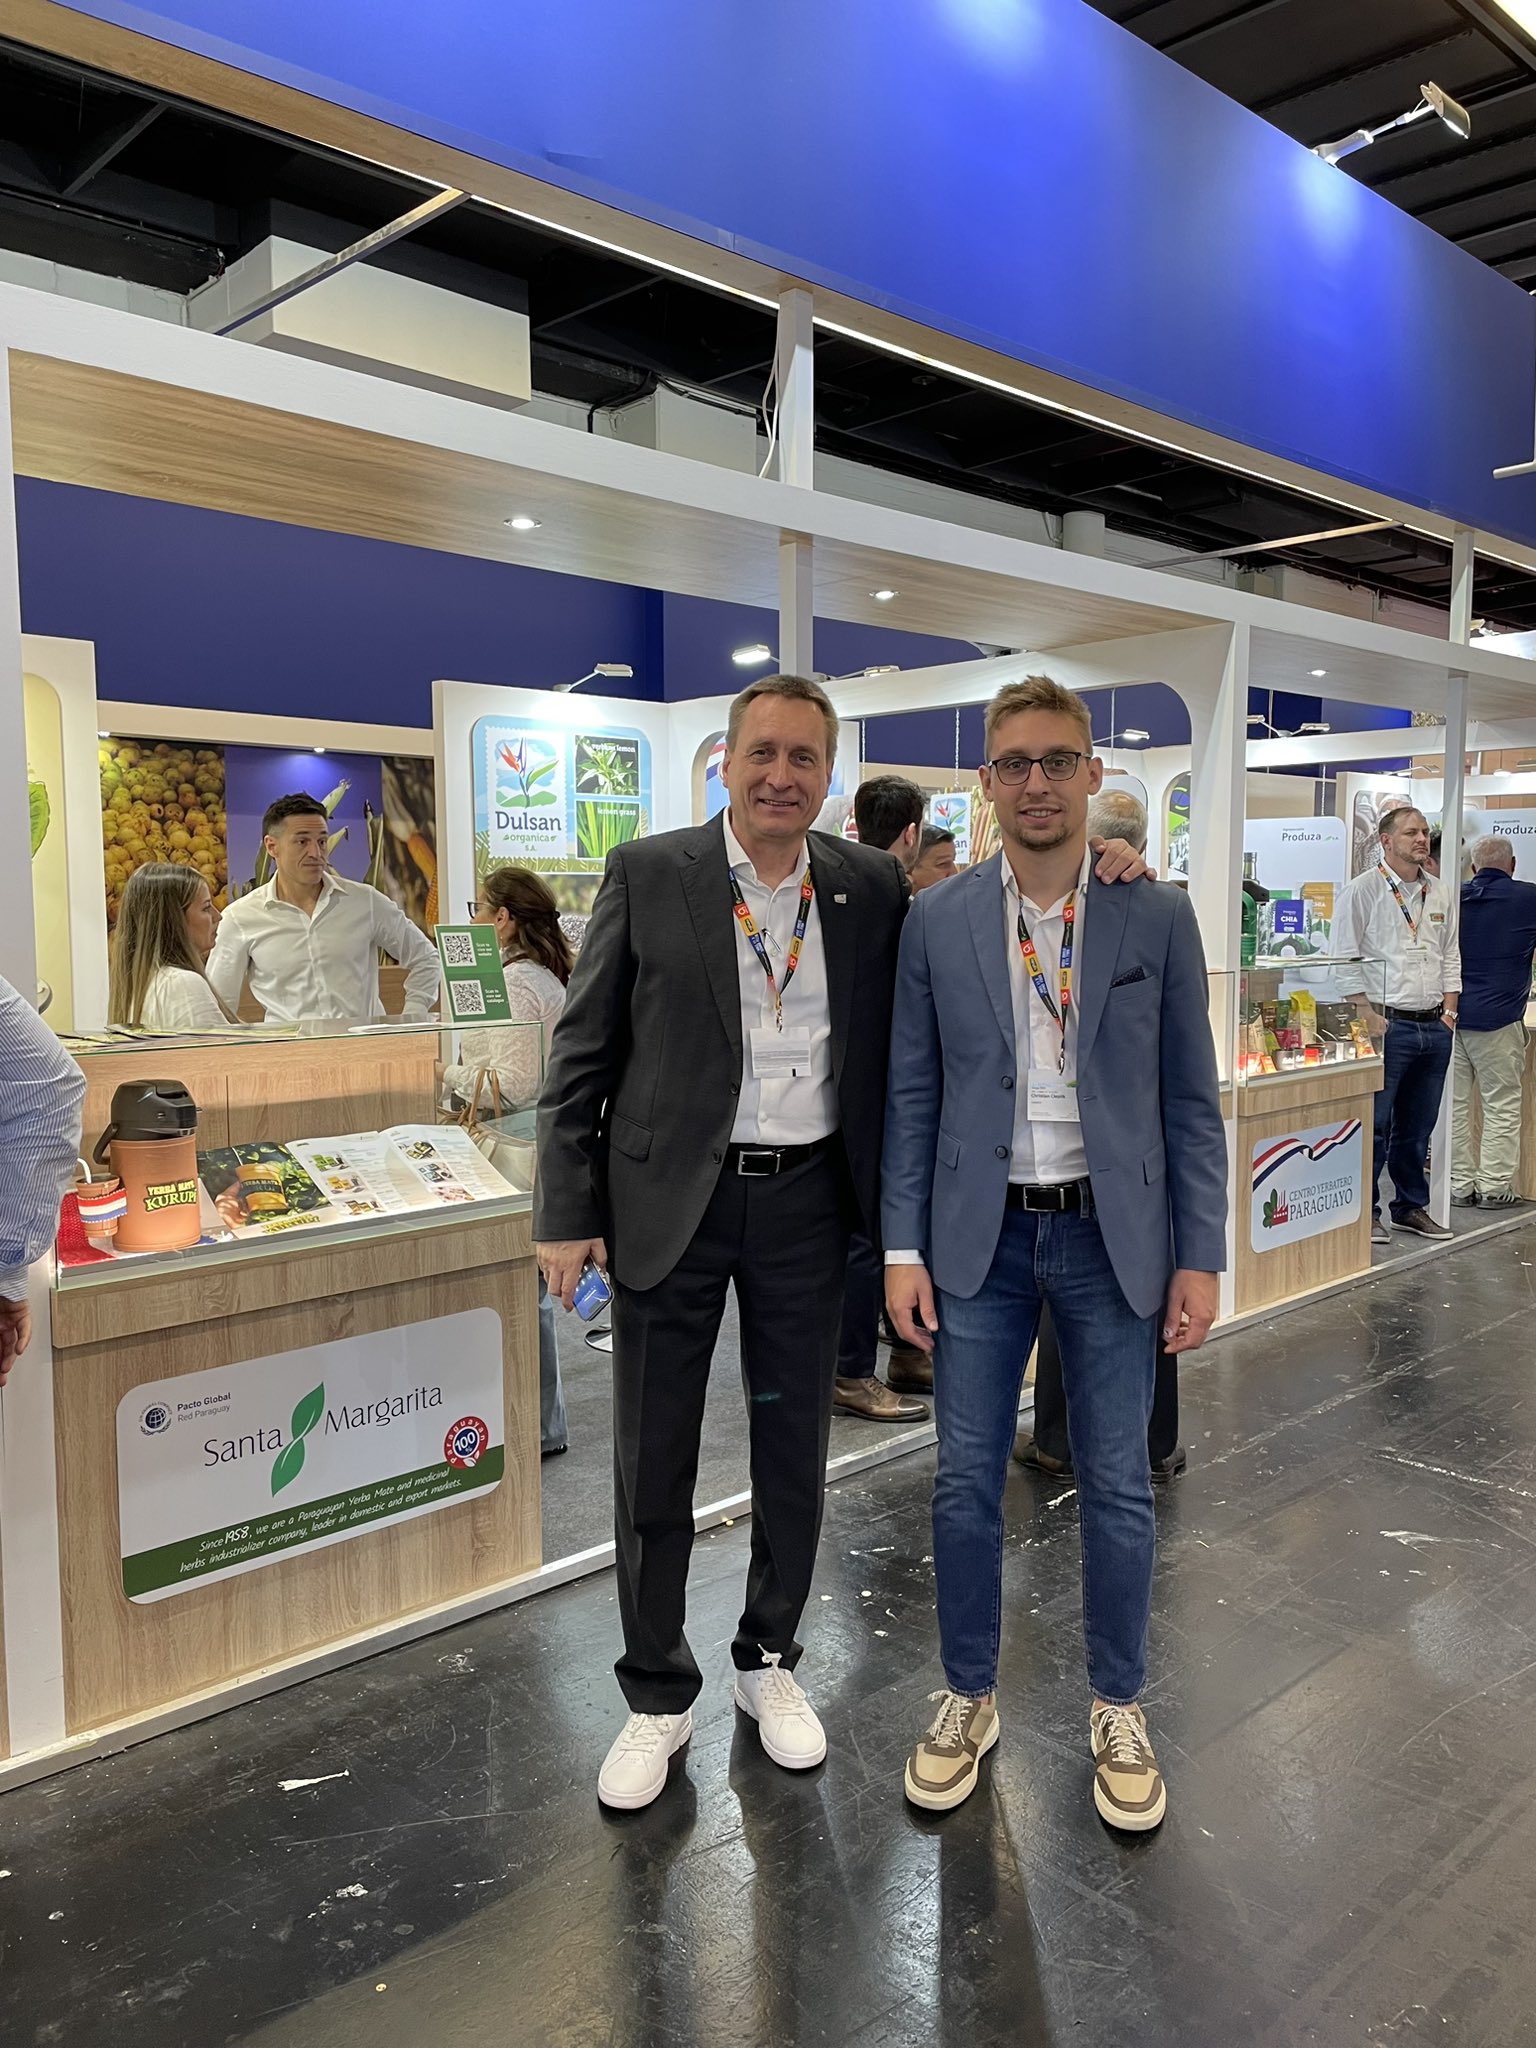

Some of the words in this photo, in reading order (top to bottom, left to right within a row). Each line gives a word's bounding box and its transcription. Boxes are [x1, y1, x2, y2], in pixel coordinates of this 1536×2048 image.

[495, 811, 562, 831] Dulsan
[510, 833, 550, 844] organica
[1282, 832, 1322, 841] Produza
[148, 1184, 176, 1195] YERBA
[1289, 1185, 1316, 1202] CENTRO
[1317, 1176, 1352, 1193] YERBATERO
[1290, 1188, 1353, 1221] PARAGUAYO
[178, 1400, 202, 1411] Pacto
[204, 1392, 231, 1405] Global
[178, 1412, 192, 1422] Red
[195, 1405, 230, 1418] Paraguay
[204, 1428, 283, 1467] Santa
[324, 1386, 442, 1435] Margarita
[456, 1432, 476, 1451] 100
[199, 1538, 224, 1552] Since
[225, 1526, 252, 1544] 1958,
[256, 1526, 269, 1535] we
[272, 1520, 285, 1530] are
[298, 1501, 345, 1522] Paraguayan
[348, 1493, 370, 1506] Yerba
[374, 1485, 395, 1499] Mate
[396, 1478, 412, 1491] and
[414, 1467, 450, 1486] medicinal
[180, 1557, 206, 1573] herbs
[209, 1540, 266, 1564] industrializer
[268, 1527, 308, 1545] company,
[311, 1517, 337, 1532] leader
[338, 1514, 347, 1523] in
[350, 1502, 385, 1520] domestic
[388, 1496, 404, 1509] and
[405, 1488, 428, 1503] export
[430, 1479, 462, 1494] markets.
